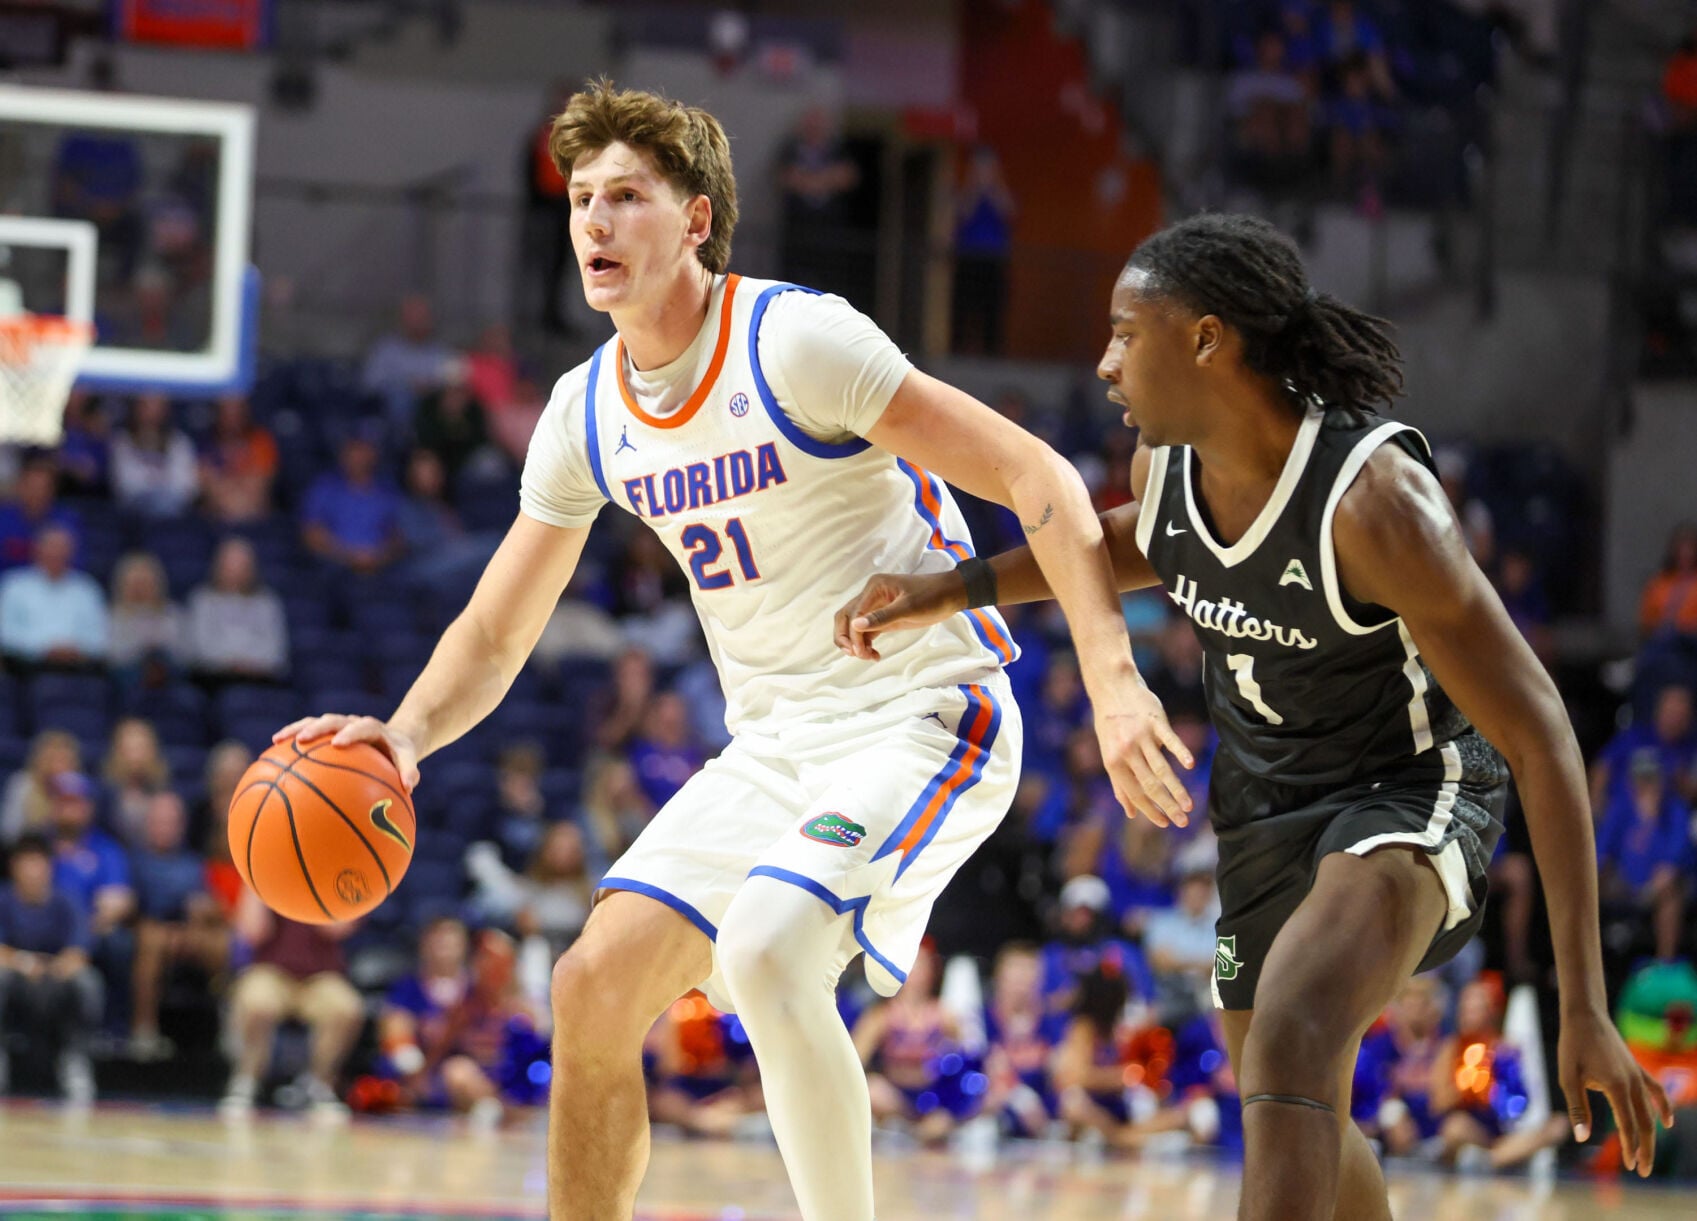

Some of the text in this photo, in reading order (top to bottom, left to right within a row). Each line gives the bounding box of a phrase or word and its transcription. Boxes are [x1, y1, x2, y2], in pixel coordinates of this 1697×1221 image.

[730, 393, 748, 416] SEC
[622, 441, 787, 517] FLORIDA
[681, 518, 760, 590] 21
[1167, 574, 1317, 649] Hatters
[1227, 654, 1283, 725] 1
